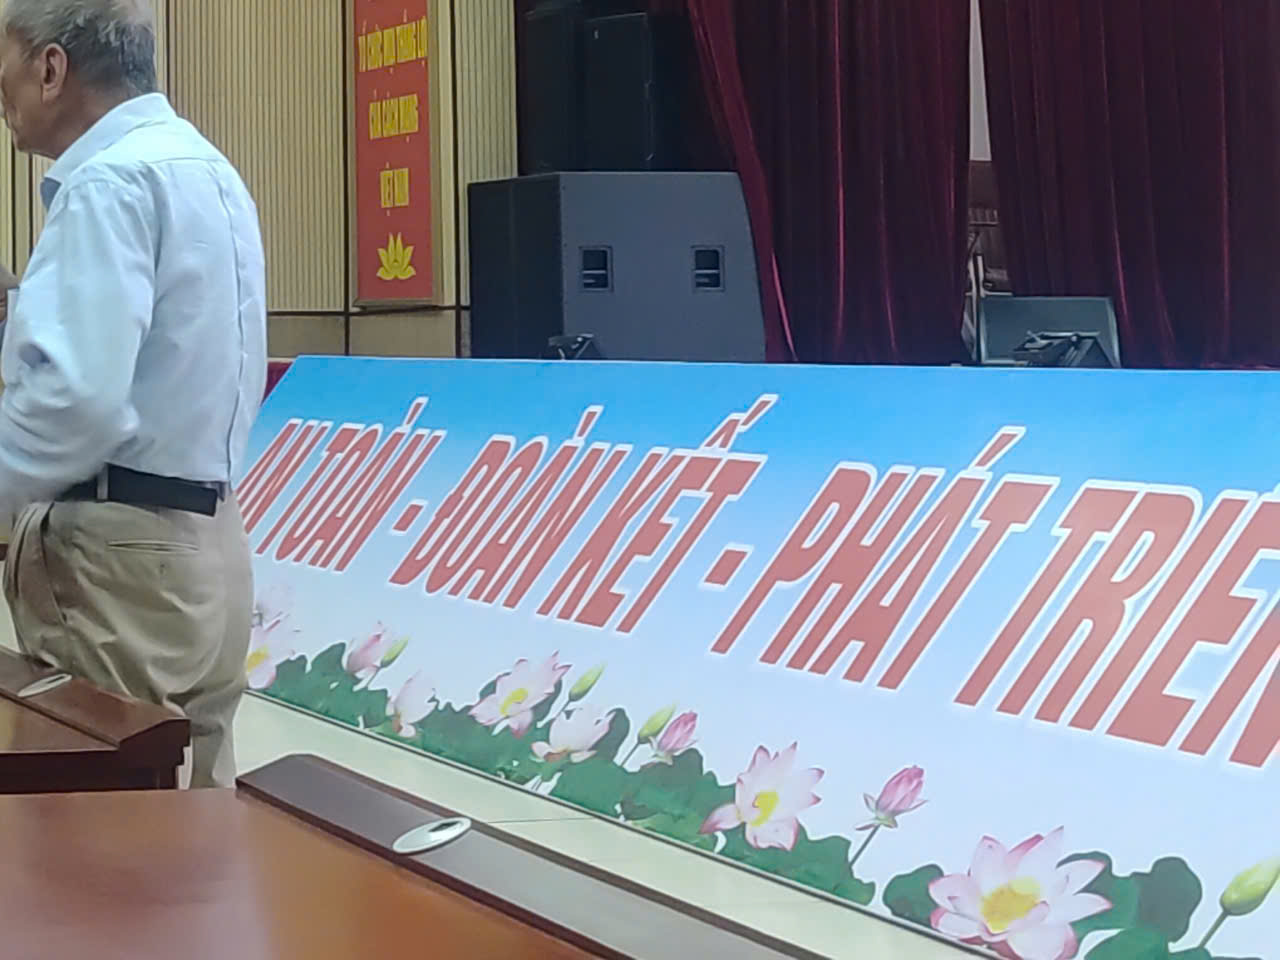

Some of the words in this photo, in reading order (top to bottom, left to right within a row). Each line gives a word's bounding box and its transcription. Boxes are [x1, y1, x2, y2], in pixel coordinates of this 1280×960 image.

[254, 396, 447, 573] TOÀN
[388, 405, 631, 610] ĐOÀN
[535, 394, 777, 635] KẾT
[708, 426, 1060, 692] PHÁT
